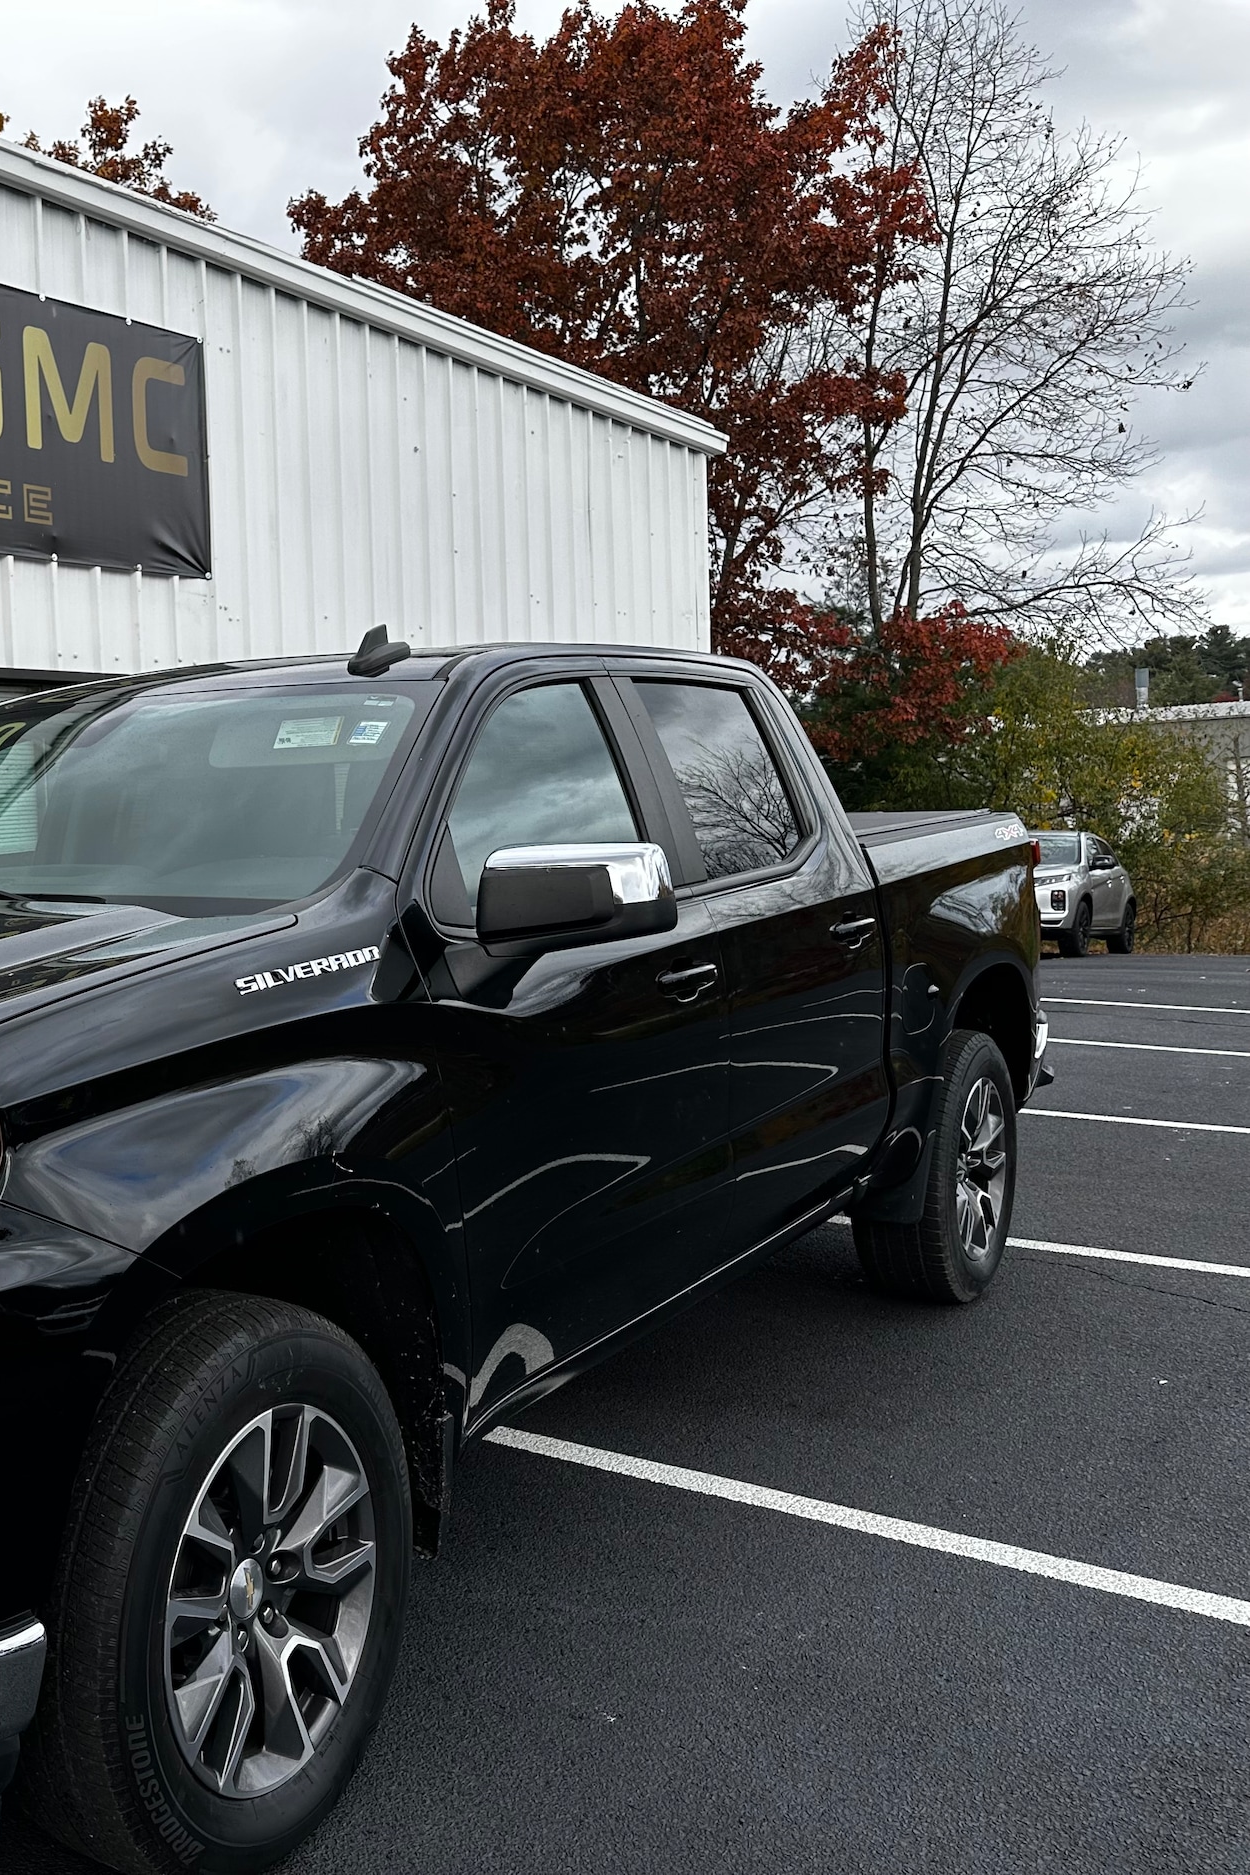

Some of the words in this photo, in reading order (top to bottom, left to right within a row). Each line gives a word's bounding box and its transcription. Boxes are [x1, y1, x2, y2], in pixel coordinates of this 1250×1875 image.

[235, 945, 381, 995] SILVERADO
[176, 1366, 242, 1459] ALENZA
[125, 1714, 206, 1866] BRIDGESTONE
